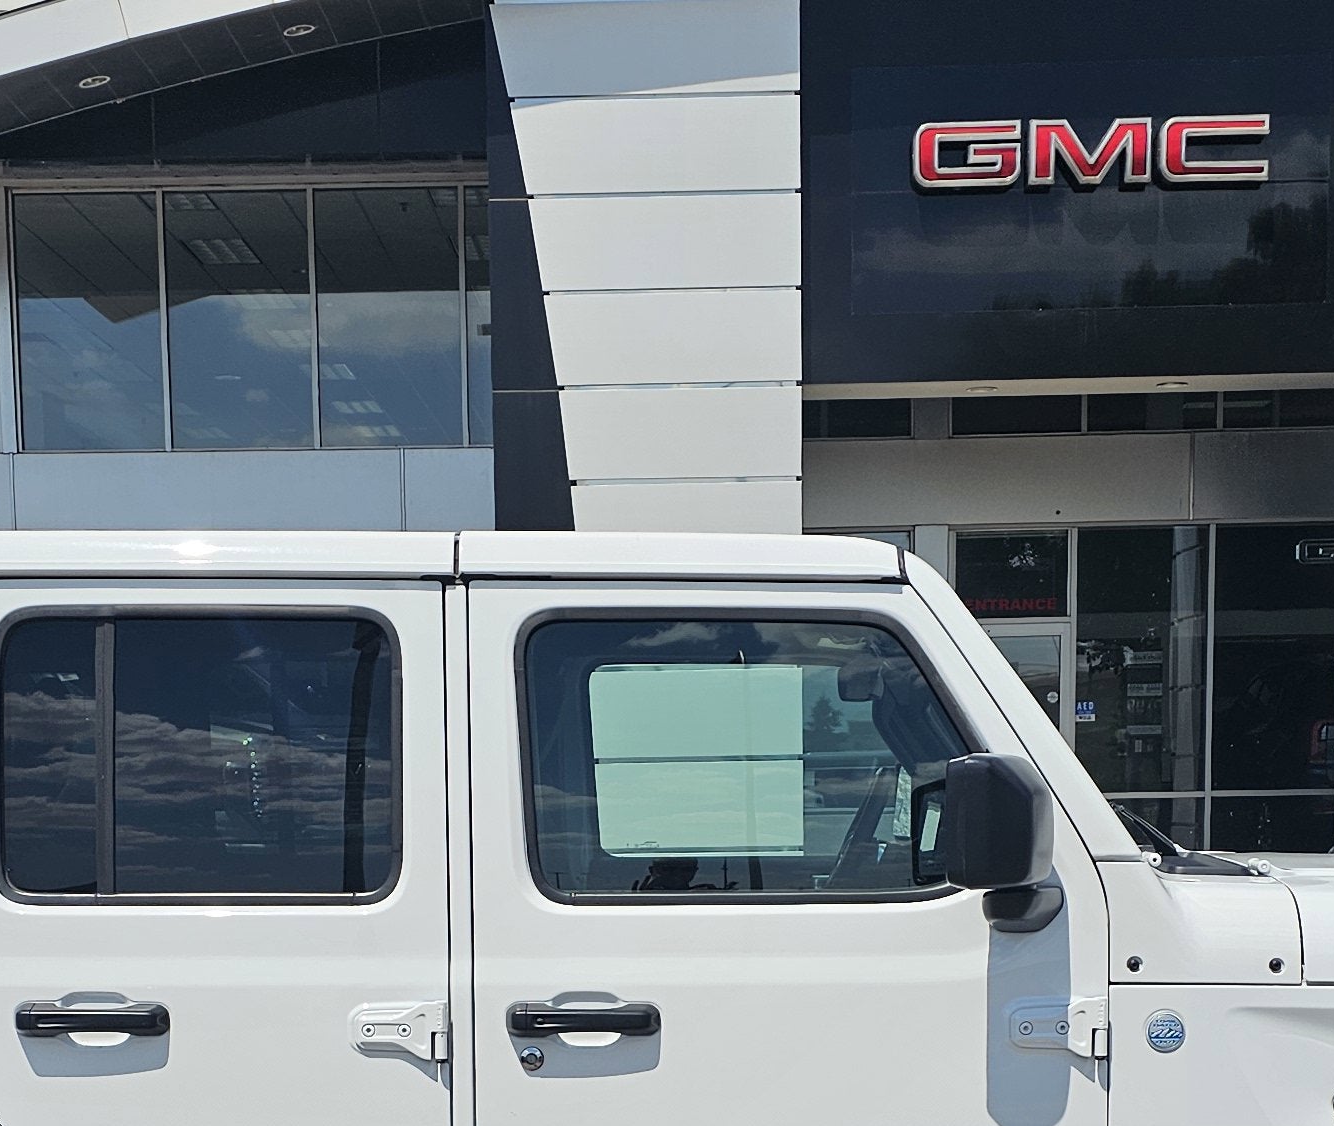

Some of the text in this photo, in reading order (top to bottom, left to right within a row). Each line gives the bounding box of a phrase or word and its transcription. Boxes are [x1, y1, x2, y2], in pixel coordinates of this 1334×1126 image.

[913, 114, 1271, 187] GMC
[966, 598, 1057, 611] ENTRANCE
[1077, 701, 1094, 710] AED
